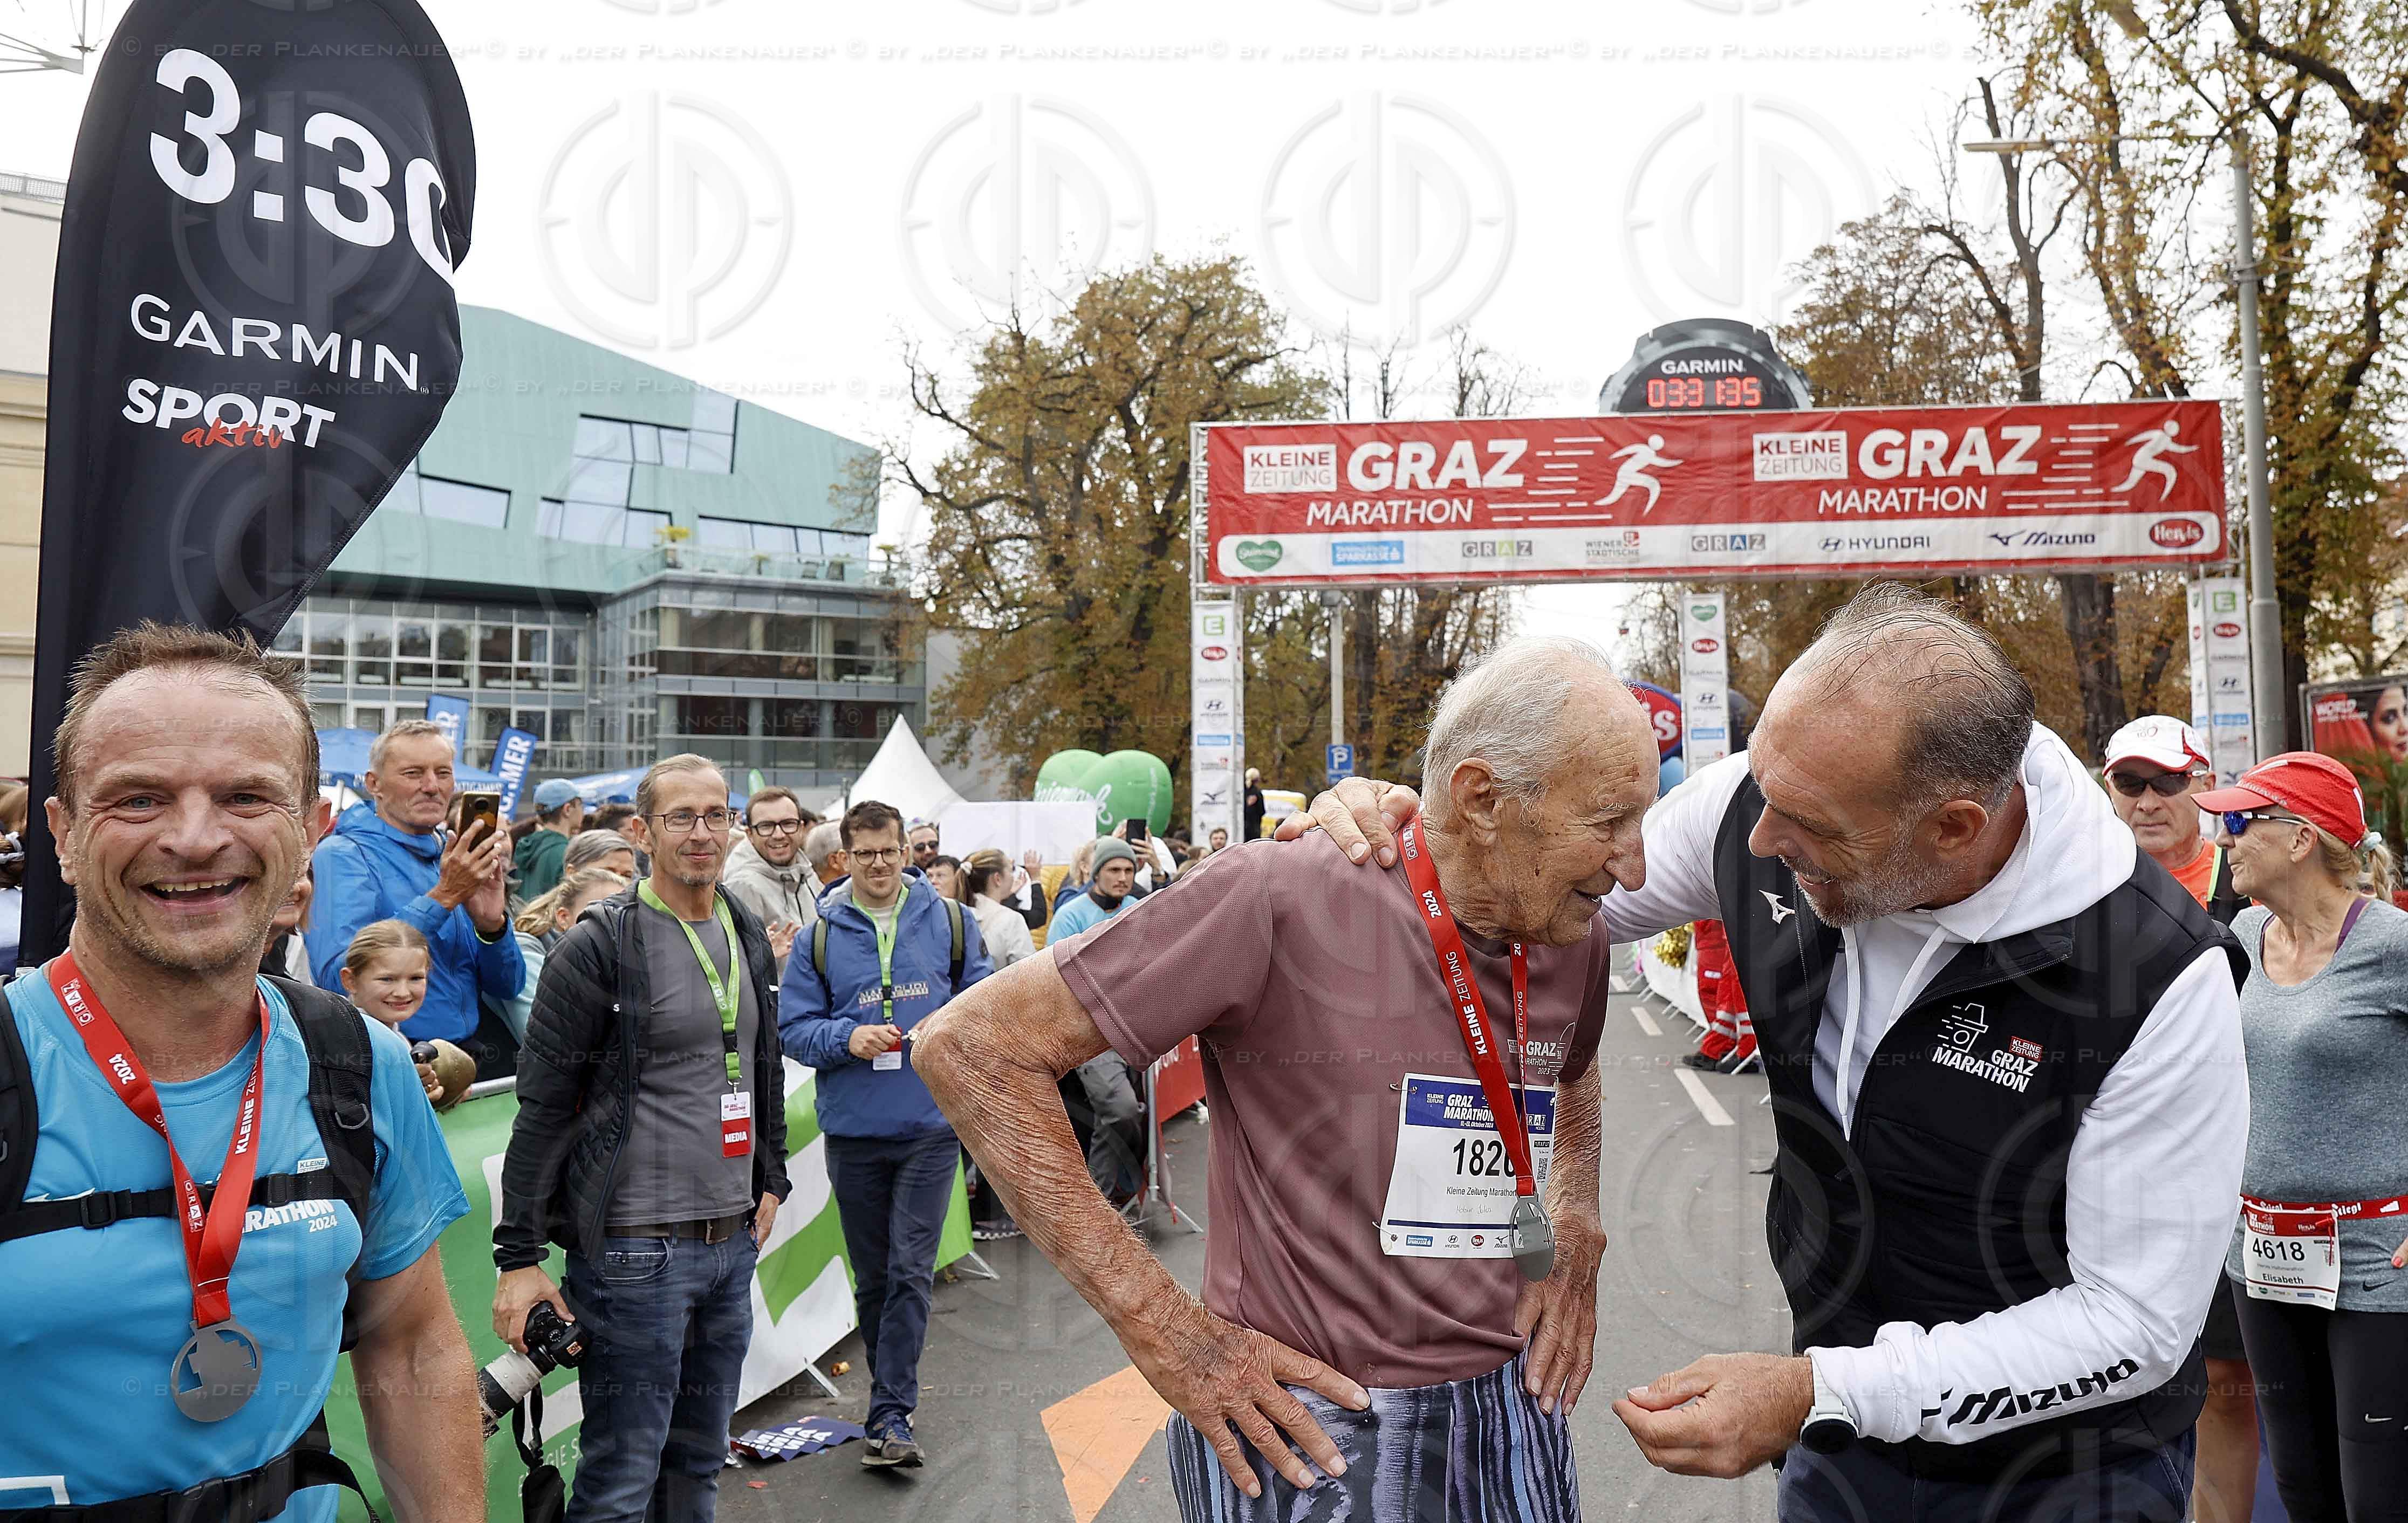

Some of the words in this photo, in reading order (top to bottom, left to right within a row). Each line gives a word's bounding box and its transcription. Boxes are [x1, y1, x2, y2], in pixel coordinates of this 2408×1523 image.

[129, 293, 418, 392] GARMIN
[1661, 358, 1744, 374] GARMIN
[122, 378, 337, 448] SPORT
[181, 417, 283, 449] aktiv
[1760, 438, 1840, 456] KLEINE
[1858, 426, 2042, 479] GRAZ
[1250, 452, 1330, 468] KLEINE
[1347, 439, 1528, 492] GRAZ
[1760, 457, 1841, 475] ZEITUNG
[1250, 469, 1331, 486] ZEITUNG
[1818, 486, 1988, 514] MARATHON
[1306, 498, 1474, 526] MARATHON
[1462, 540, 1532, 557] GRAZ
[1692, 534, 1766, 552] GRAZ
[1849, 536, 1931, 550] HYUNDAI
[1421, 890, 1441, 918] 2024
[1446, 951, 1471, 1002] ZEITUNG
[61, 979, 95, 1026] GRAZ
[1463, 1004, 1488, 1055] KLEINE
[1526, 1041, 1556, 1057] GRAZ
[2011, 1045, 2040, 1059] ZEITUNG
[2013, 1039, 2042, 1053] KLEINE
[108, 1053, 136, 1085] 2024
[1932, 1047, 2030, 1093] MARATHON
[1992, 1049, 2038, 1076] GRAZ
[1447, 1094, 1473, 1108] GRAZ
[1444, 1106, 1494, 1122] MARATHON
[1527, 1114, 1546, 1126] RAZ
[235, 1098, 255, 1155] KLEINE
[724, 1131, 748, 1143] MEDIA
[1446, 1186, 1466, 1196] Kleine
[1467, 1187, 1488, 1198] Zeitung
[1489, 1187, 1516, 1197] Marathon
[242, 1199, 335, 1234] RATHON
[309, 1215, 338, 1233] 2024
[2253, 1238, 2305, 1261] 4618
[2262, 1273, 2303, 1285] Elisabeth
